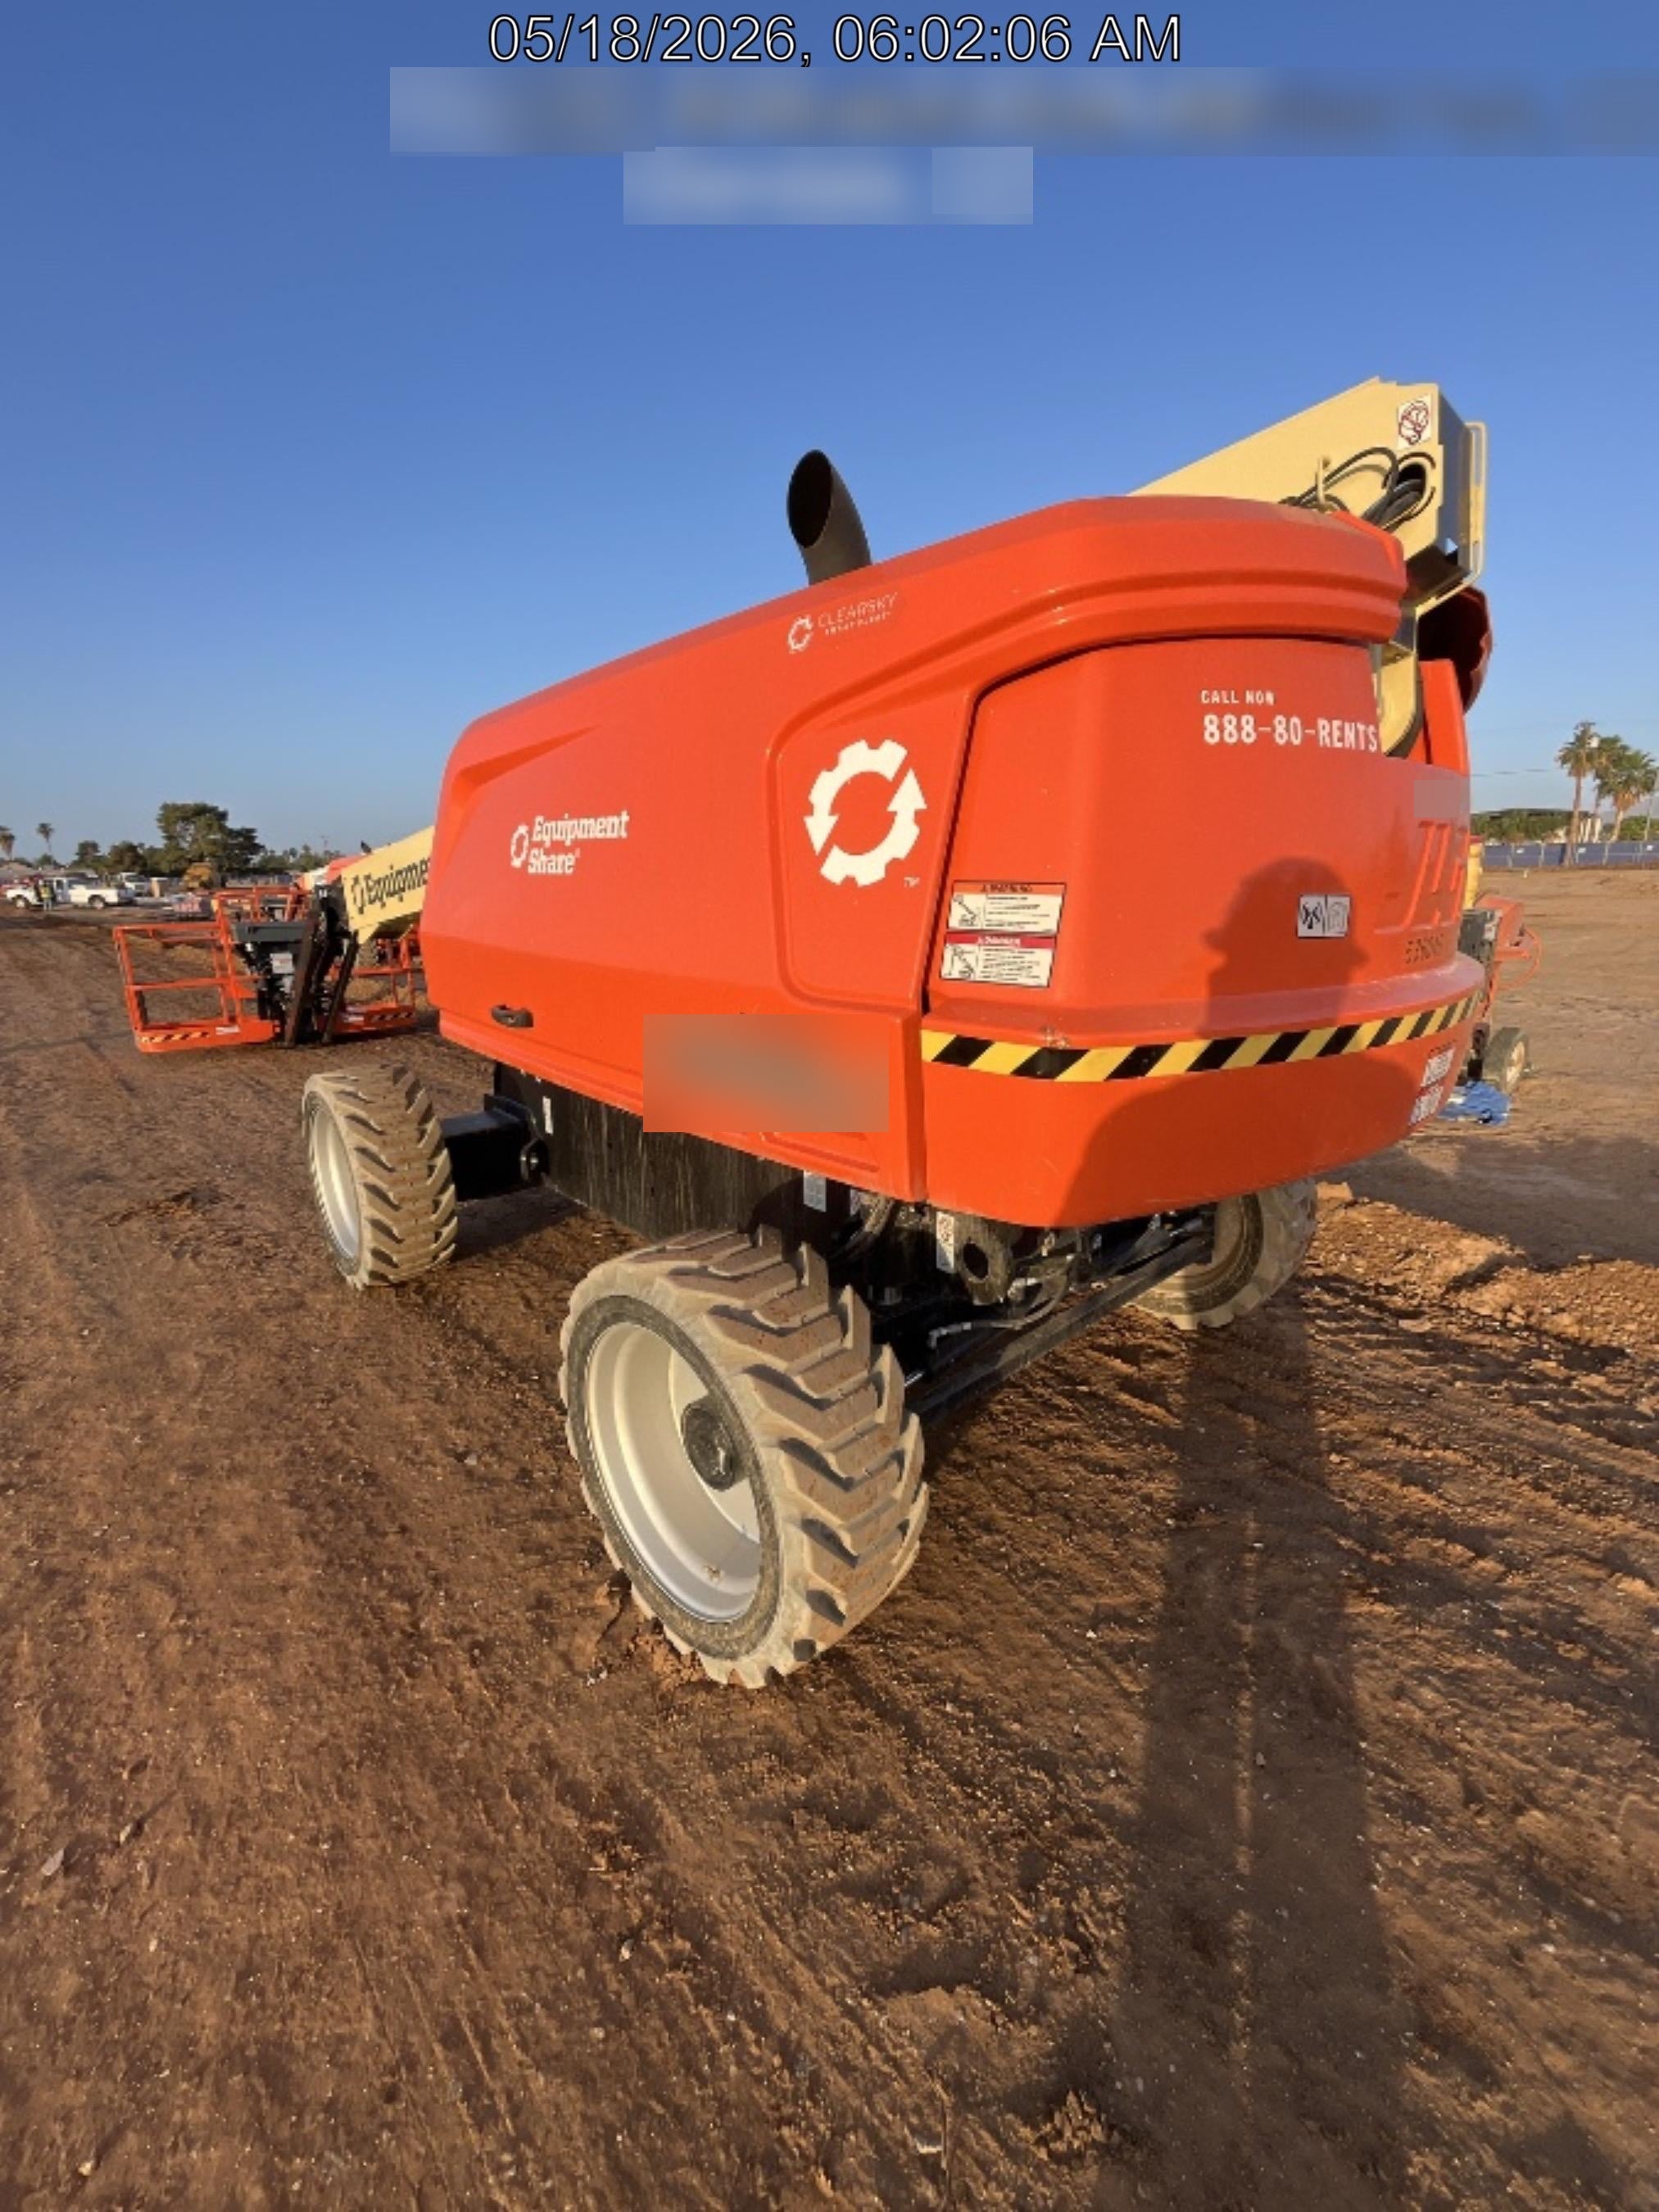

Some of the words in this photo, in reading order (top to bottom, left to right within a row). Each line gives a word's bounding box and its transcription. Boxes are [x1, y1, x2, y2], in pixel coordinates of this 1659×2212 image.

[1201, 690, 1240, 705] CALL
[1203, 713, 1378, 753] 888-80-RENTS
[533, 809, 630, 848] Equipment
[528, 846, 576, 874] Share
[363, 857, 431, 910] Equipme
